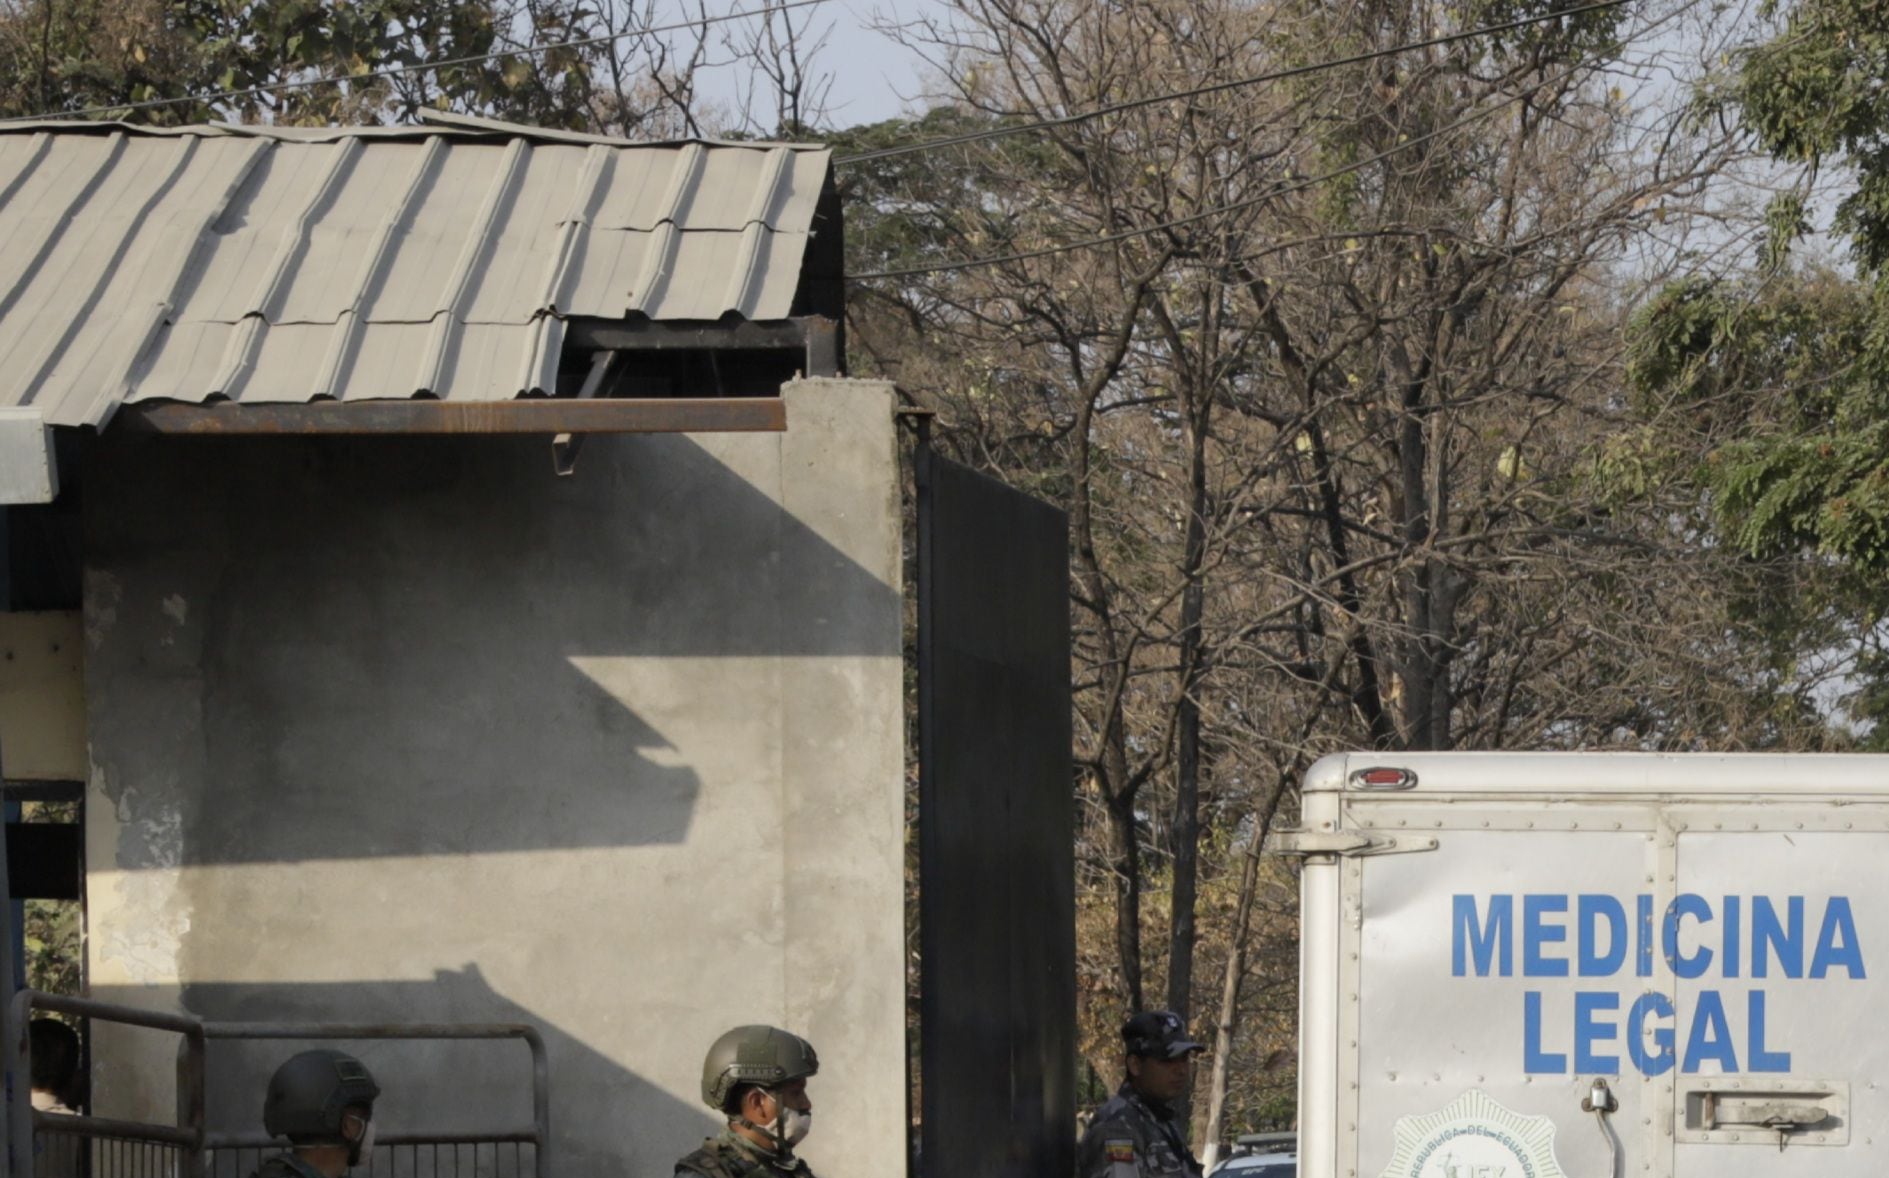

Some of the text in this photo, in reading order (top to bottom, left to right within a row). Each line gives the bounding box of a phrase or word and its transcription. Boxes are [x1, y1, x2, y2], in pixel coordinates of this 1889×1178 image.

[1452, 893, 1866, 979] MEDICINA
[1523, 990, 1791, 1075] LEGAL
[1410, 1127, 1460, 1178] REPUBLICA
[1467, 1125, 1490, 1138] DEL
